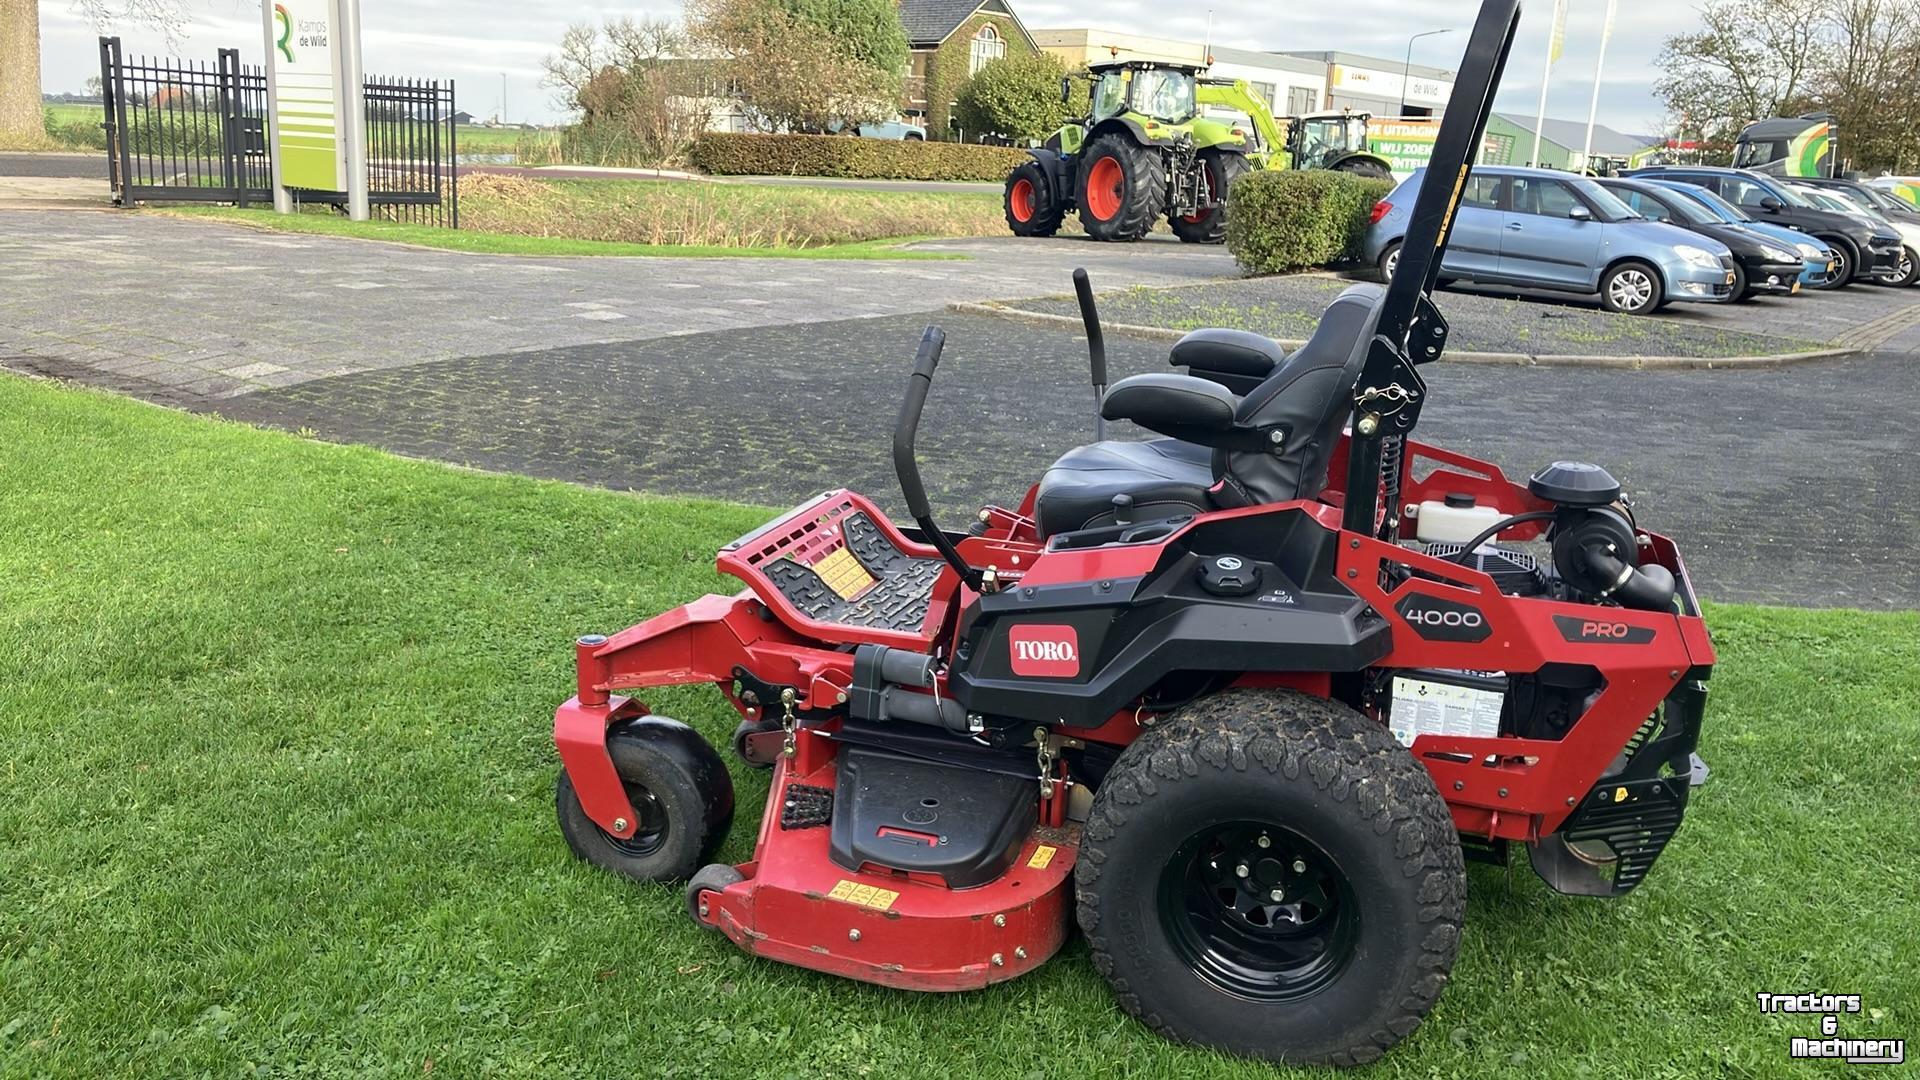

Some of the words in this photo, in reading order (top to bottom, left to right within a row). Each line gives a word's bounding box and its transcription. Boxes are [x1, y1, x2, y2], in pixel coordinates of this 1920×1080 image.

[298, 19, 327, 33] Kamps
[299, 35, 309, 47] de
[310, 35, 327, 47] Wild
[1383, 124, 1441, 138] UITDAGIN
[1380, 142, 1401, 154] WIJ
[1403, 143, 1433, 156] ZOEK
[1405, 608, 1482, 628] 4000
[1581, 621, 1629, 638] PRO
